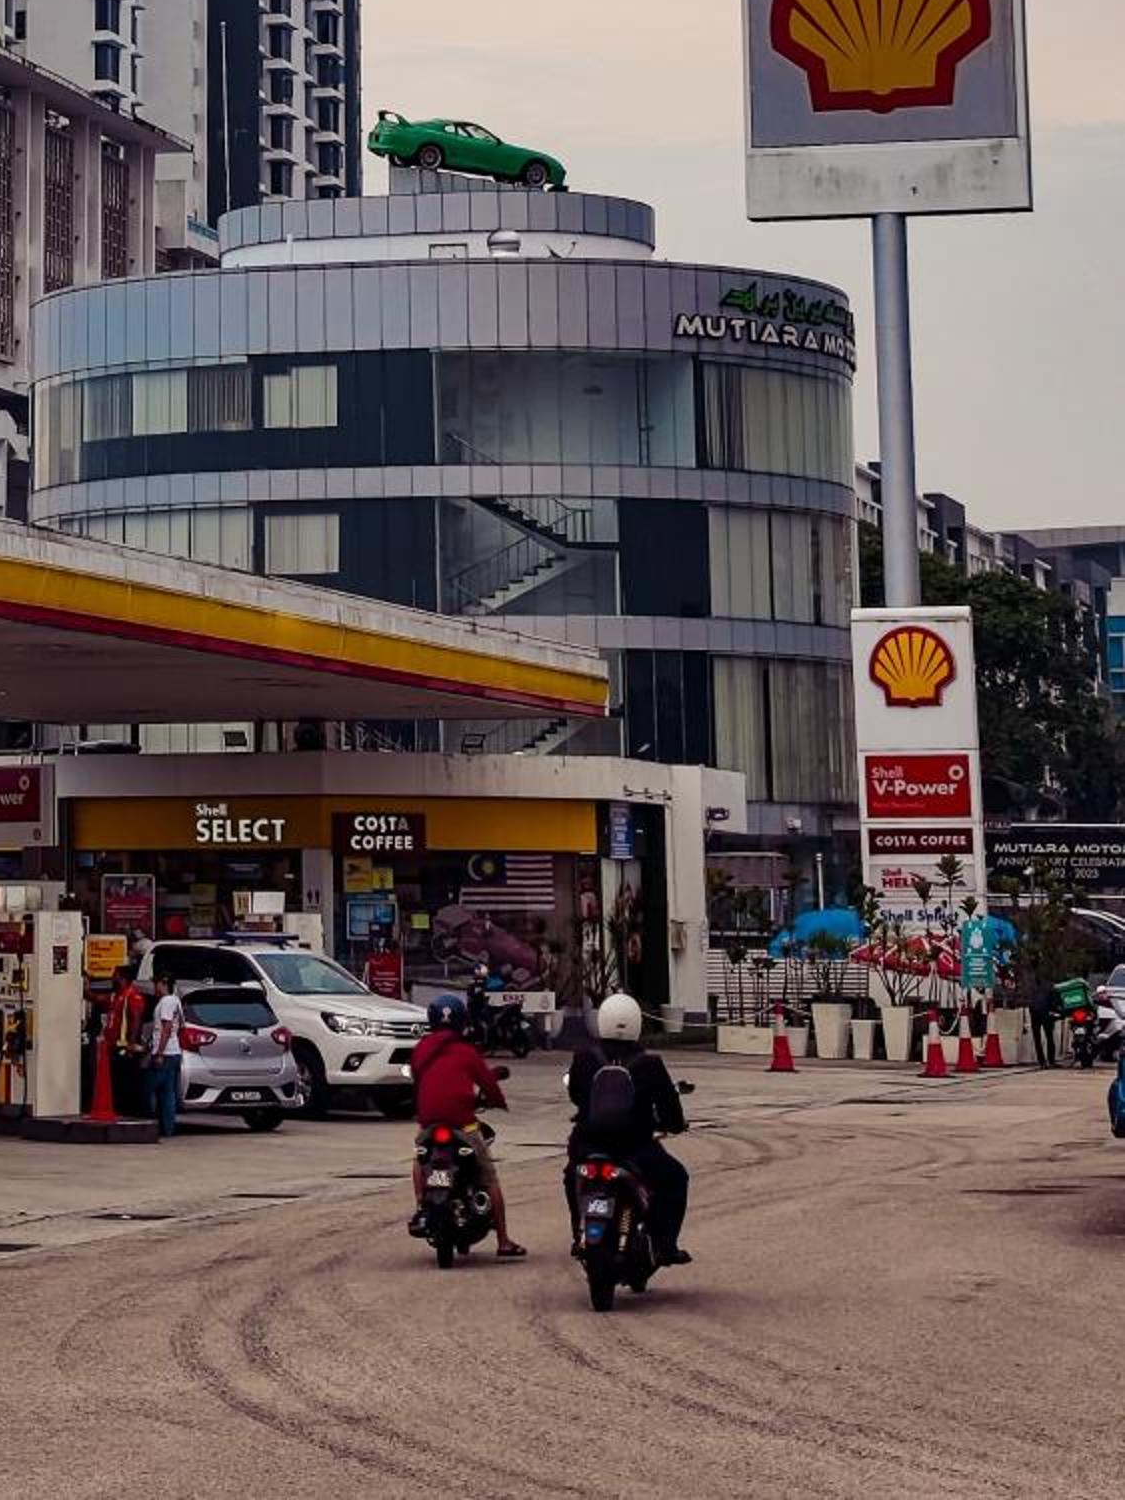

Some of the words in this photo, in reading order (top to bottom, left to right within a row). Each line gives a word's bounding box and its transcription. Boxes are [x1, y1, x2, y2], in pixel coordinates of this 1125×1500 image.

[676, 314, 819, 350] MUTIARA
[871, 765, 904, 779] Shell
[873, 779, 958, 796] V-Power
[196, 803, 227, 817] Shell
[196, 818, 285, 843] SELECT
[354, 815, 410, 832] COSTA
[350, 836, 414, 850] COFFEE
[875, 835, 916, 847] COSTA
[920, 835, 967, 846] COFFEE
[994, 842, 1069, 853] MUTIARA
[1074, 843, 1125, 854] MOTO
